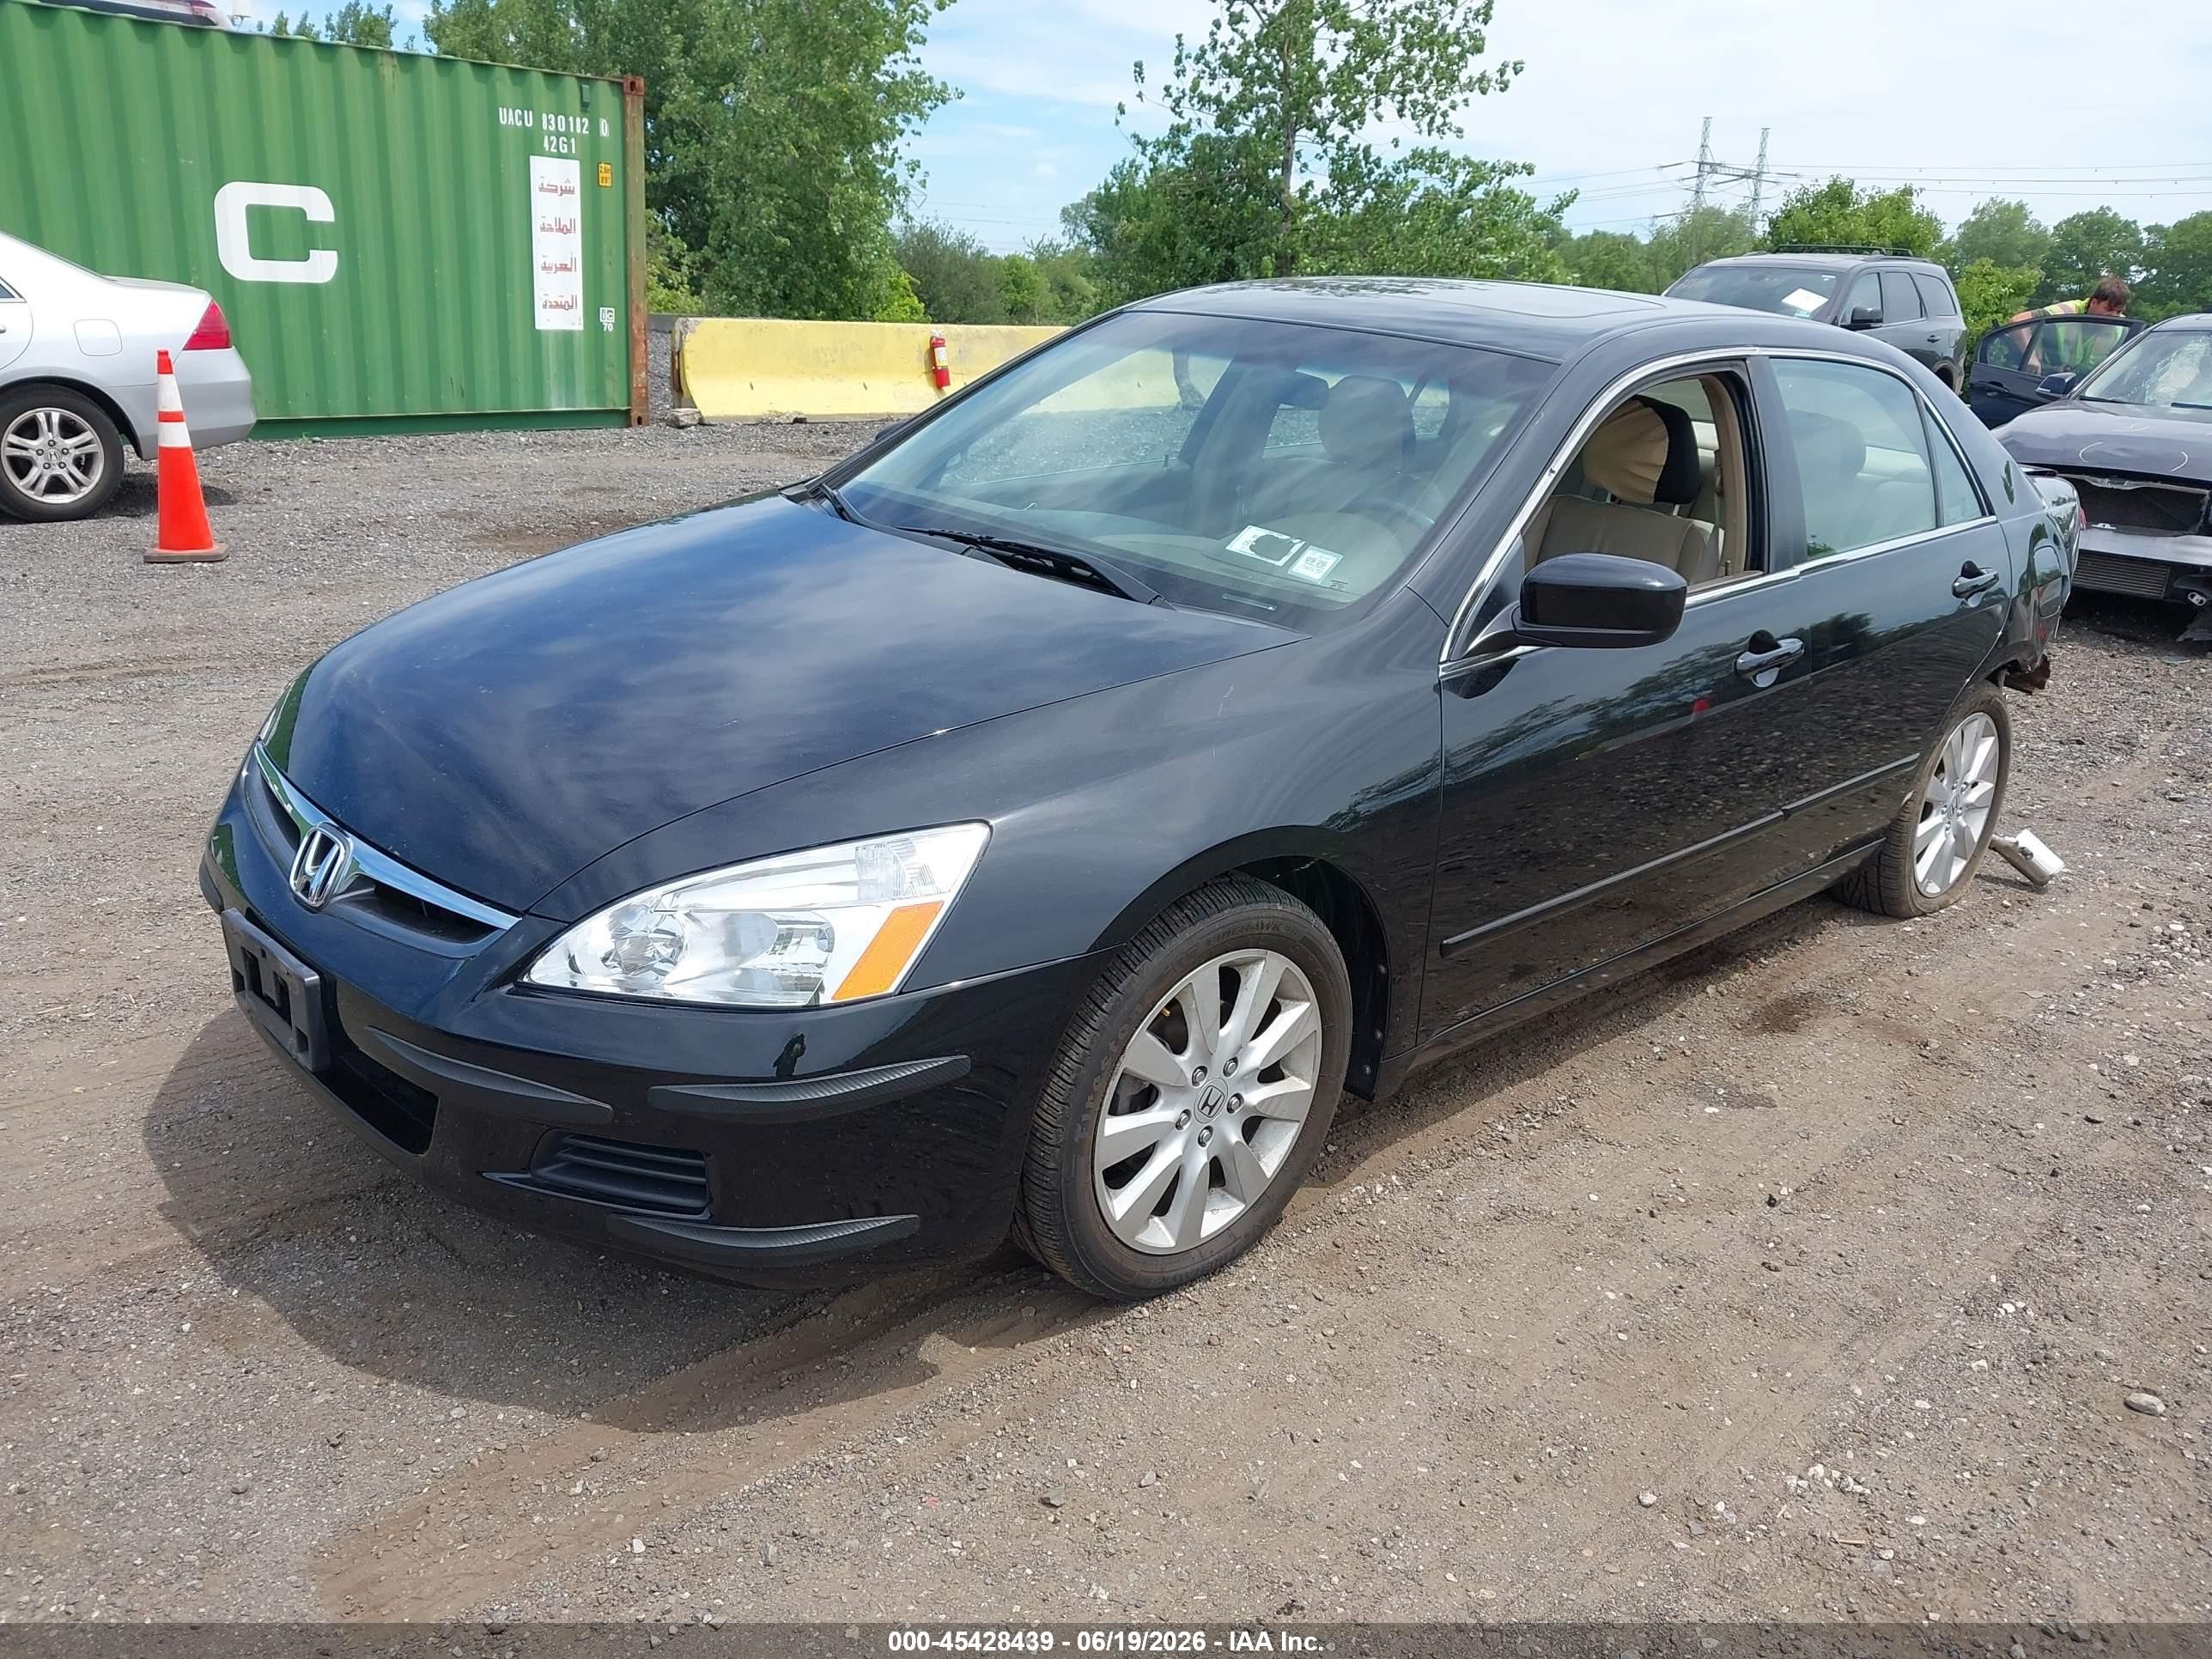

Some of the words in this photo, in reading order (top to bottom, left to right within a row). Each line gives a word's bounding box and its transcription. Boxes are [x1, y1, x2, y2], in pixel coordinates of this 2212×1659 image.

[499, 107, 533, 127] UACU
[542, 112, 589, 134] 830182
[544, 136, 576, 154] 42G1
[538, 176, 575, 197] شركة
[214, 181, 338, 283] C
[539, 216, 576, 234] الملاحة
[541, 255, 577, 274] العربية
[542, 294, 578, 311] المتحدة
[603, 322, 613, 331] 70
